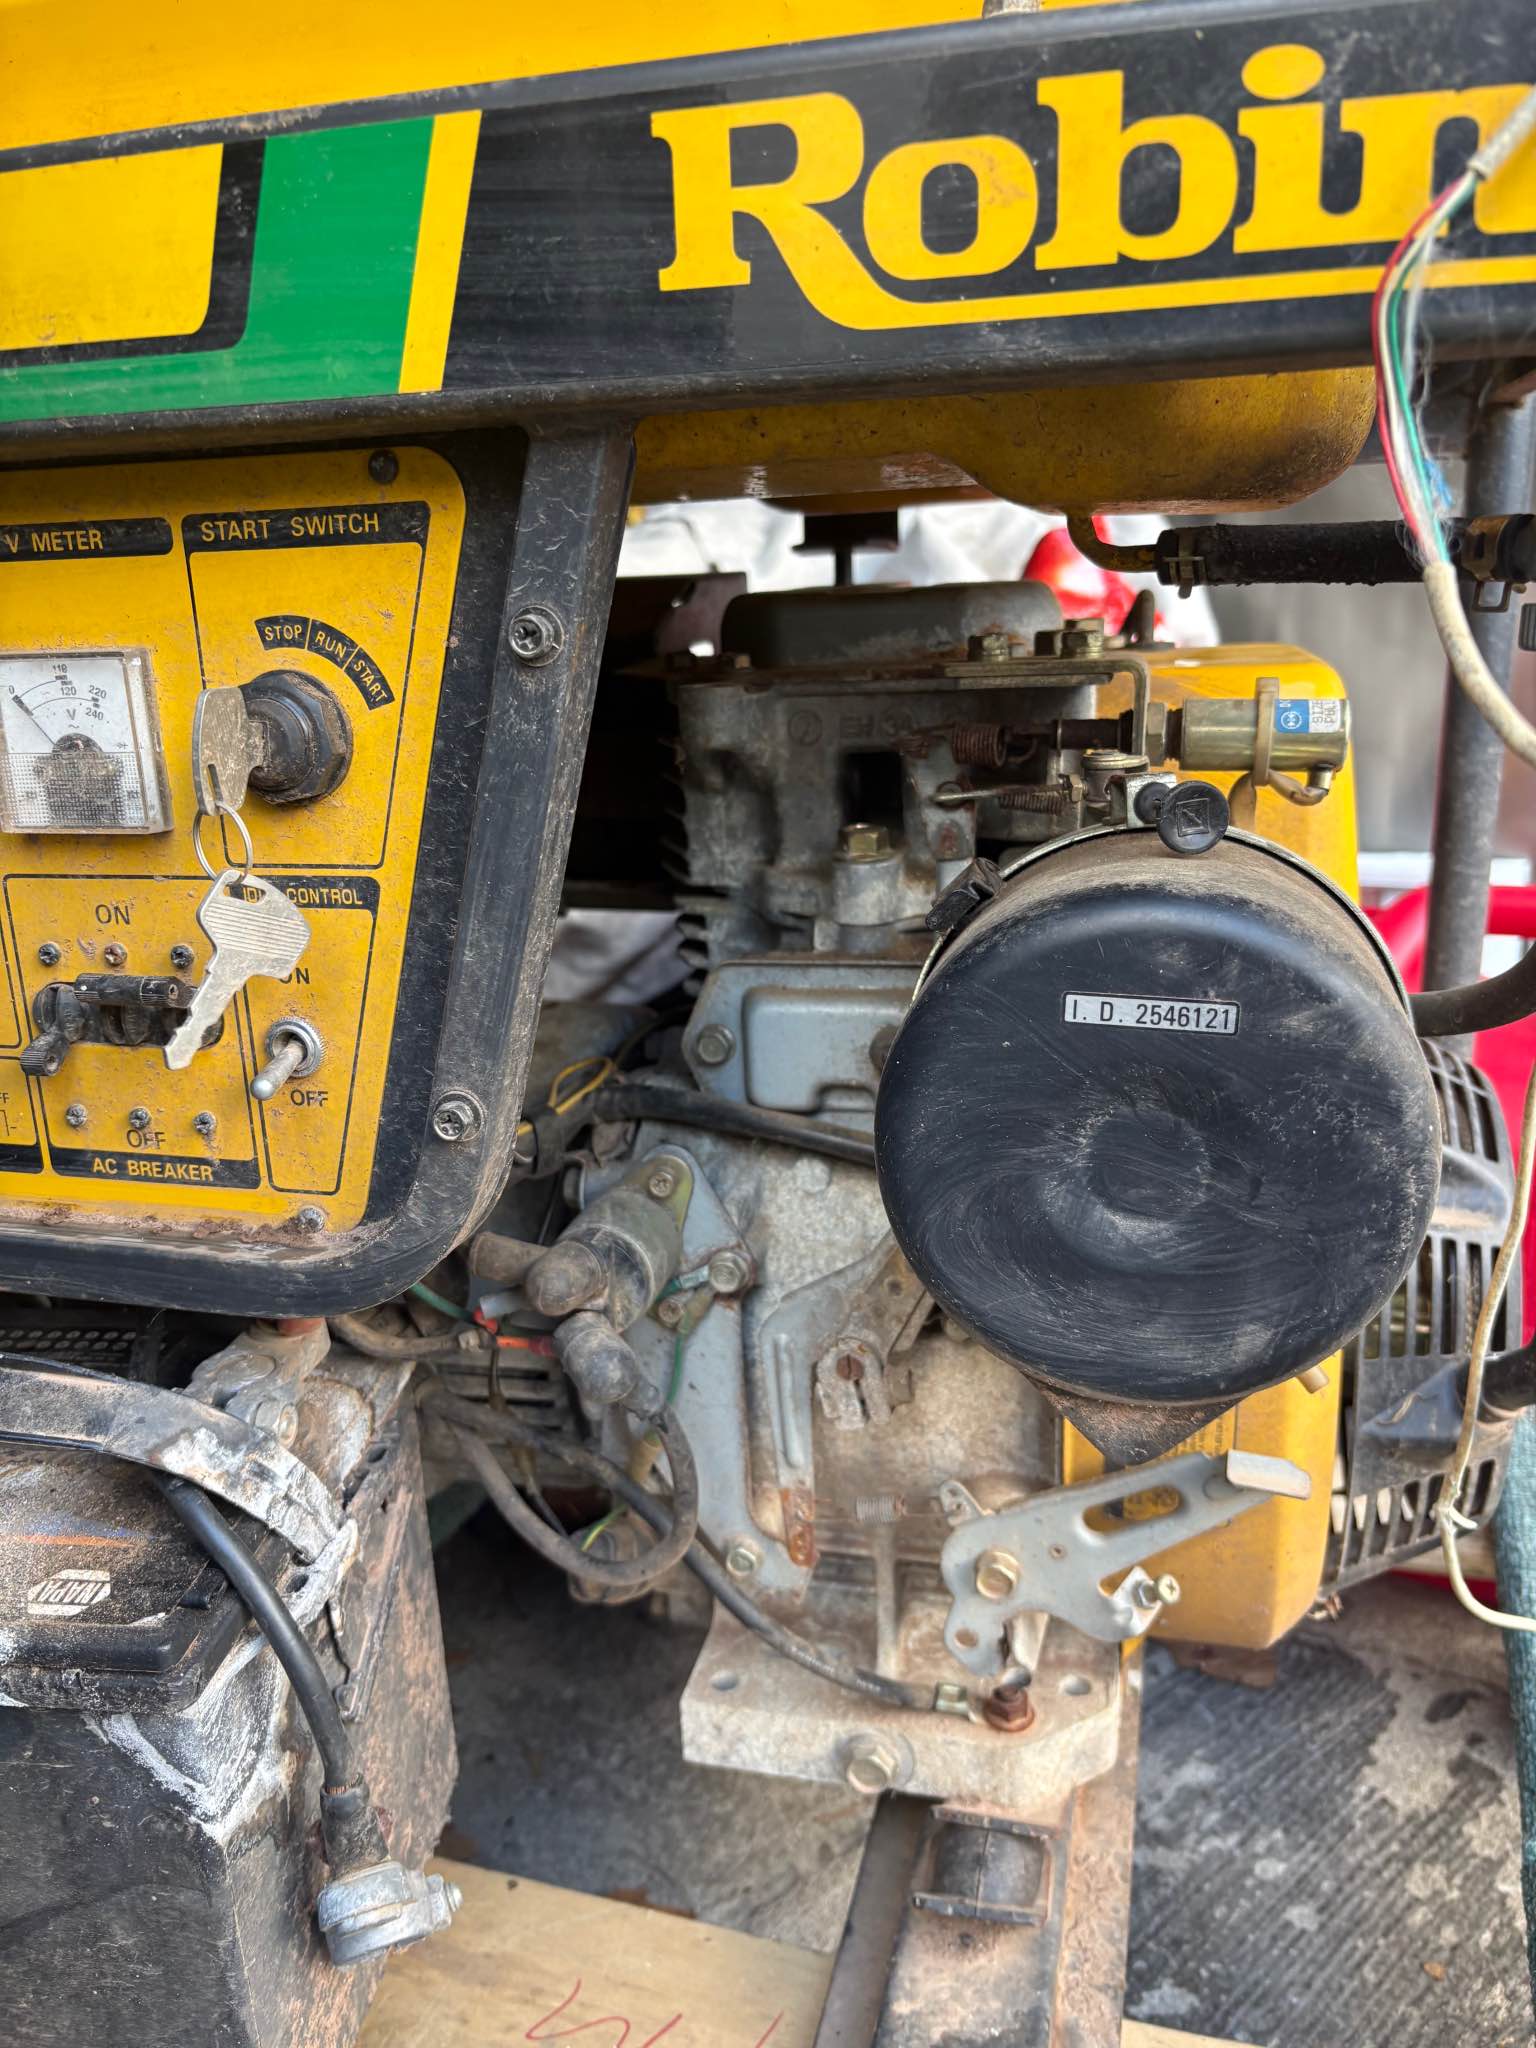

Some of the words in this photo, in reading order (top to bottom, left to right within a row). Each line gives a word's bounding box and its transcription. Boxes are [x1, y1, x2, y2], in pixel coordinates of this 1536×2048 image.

[650, 44, 1536, 330] Robin
[200, 519, 271, 542] START
[291, 512, 379, 537] SWITCH
[5, 533, 19, 553] V
[31, 529, 104, 552] METER
[264, 624, 302, 641] STOP
[315, 631, 347, 659] RUN
[353, 659, 388, 702] START
[60, 686, 77, 696] 120
[88, 685, 107, 699] 220
[66, 709, 76, 721] V
[85, 707, 104, 721] 240
[286, 887, 363, 905] CONTROL
[95, 904, 131, 925] ON
[1072, 999, 1087, 1021] I.
[1100, 1001, 1124, 1024] D.
[1135, 1003, 1230, 1030] 2546121
[290, 1089, 329, 1107] OFF
[126, 1129, 167, 1149] OFF
[92, 1157, 118, 1175] AC
[127, 1160, 214, 1182] BREAKER
